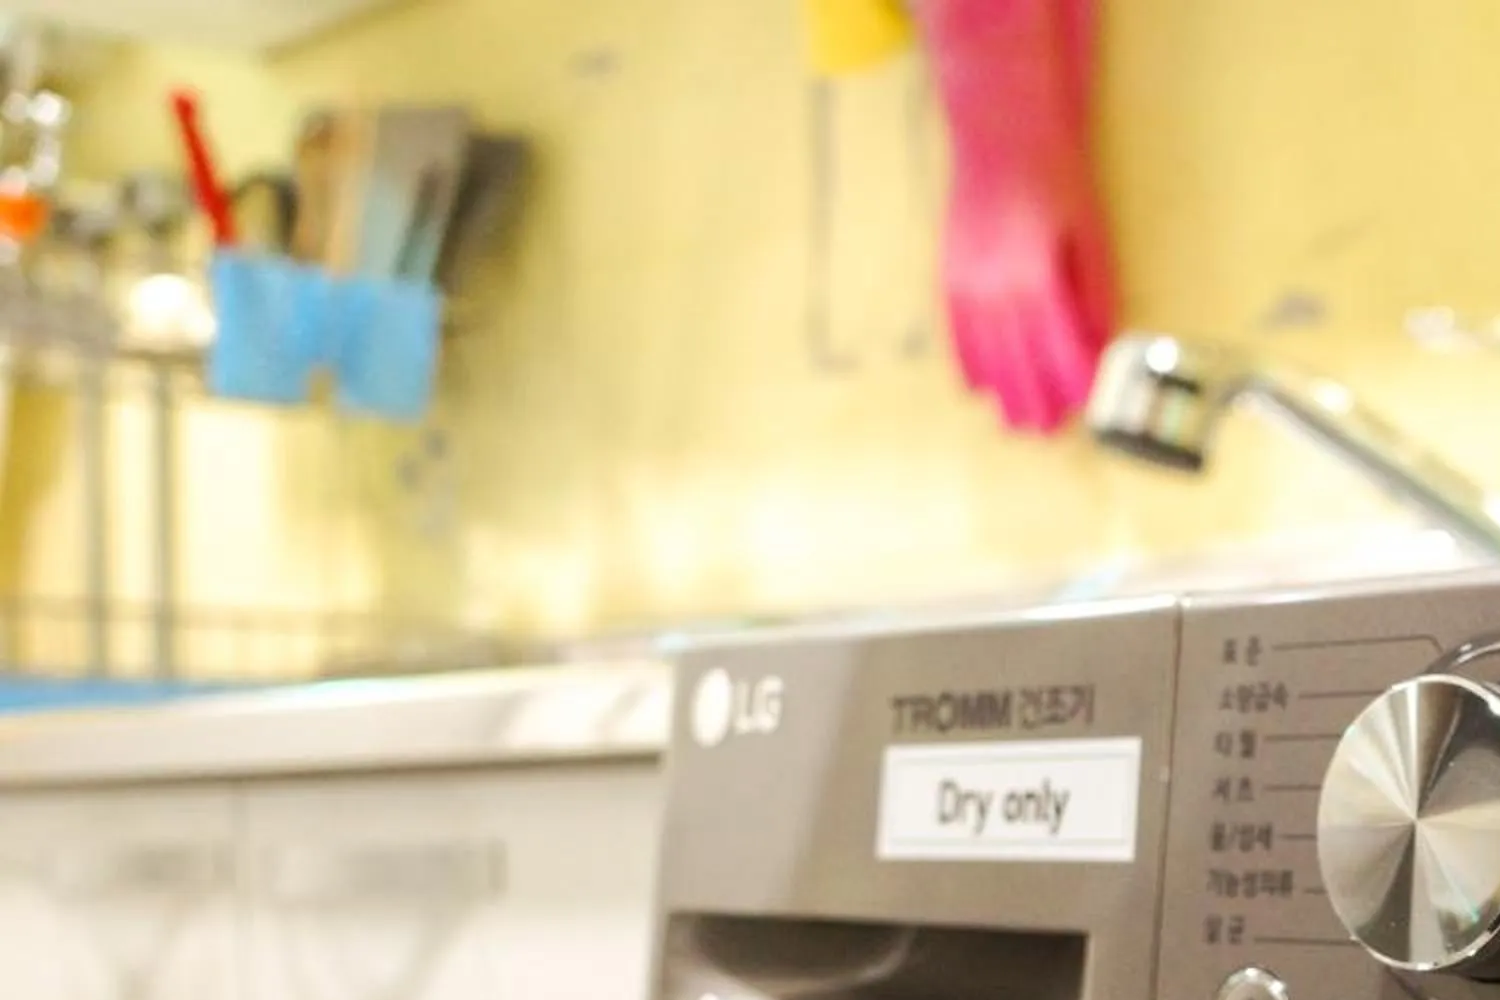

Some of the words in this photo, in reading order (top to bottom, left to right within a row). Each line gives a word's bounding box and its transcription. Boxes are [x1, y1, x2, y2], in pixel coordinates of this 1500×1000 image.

[734, 673, 784, 735] LG
[890, 690, 1012, 734] TROMM
[936, 777, 994, 837] Dry
[1001, 776, 1071, 838] only
